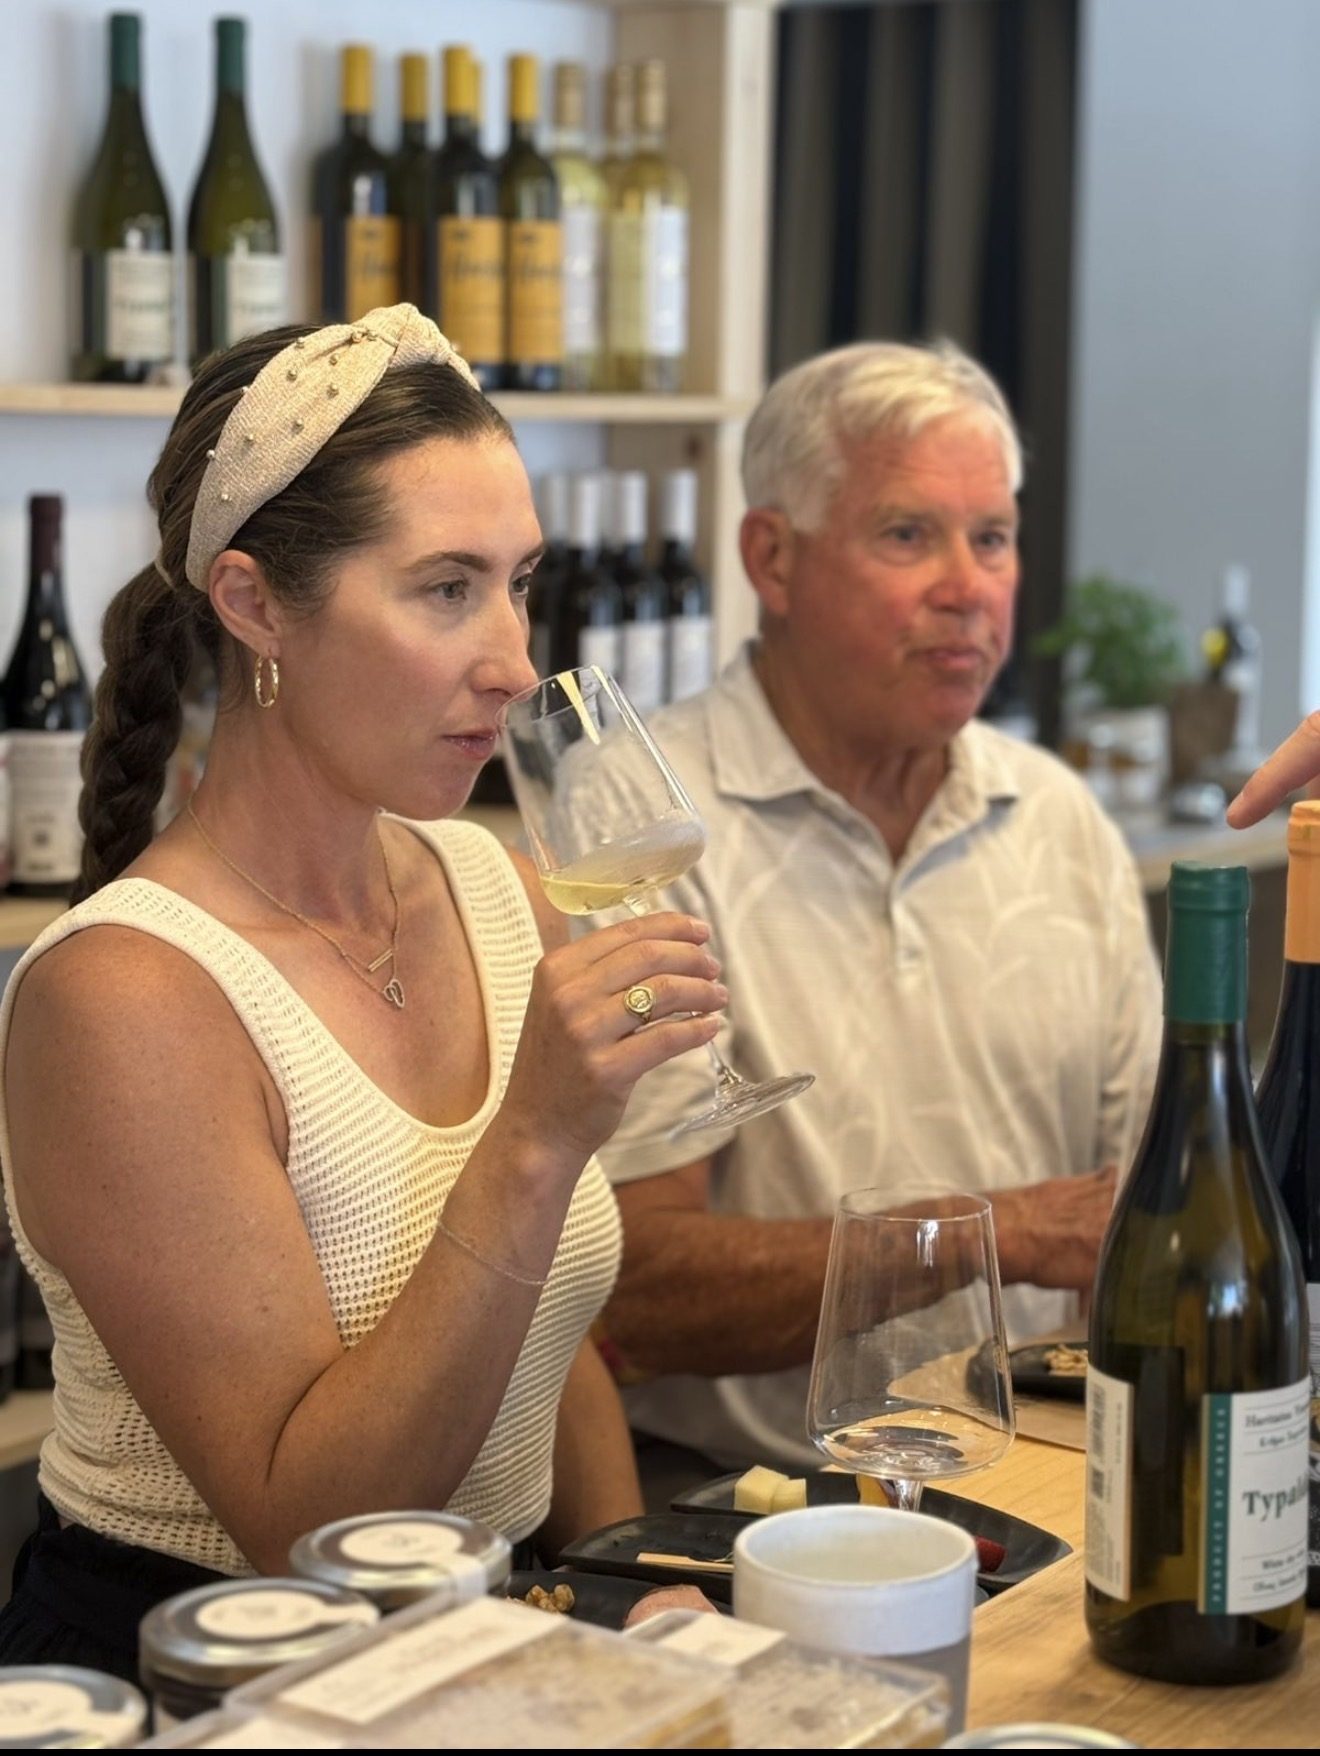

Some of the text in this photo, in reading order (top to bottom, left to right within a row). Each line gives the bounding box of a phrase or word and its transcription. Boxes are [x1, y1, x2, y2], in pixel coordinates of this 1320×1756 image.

[1211, 1408, 1226, 1602] PRODUCT OF GREECE
